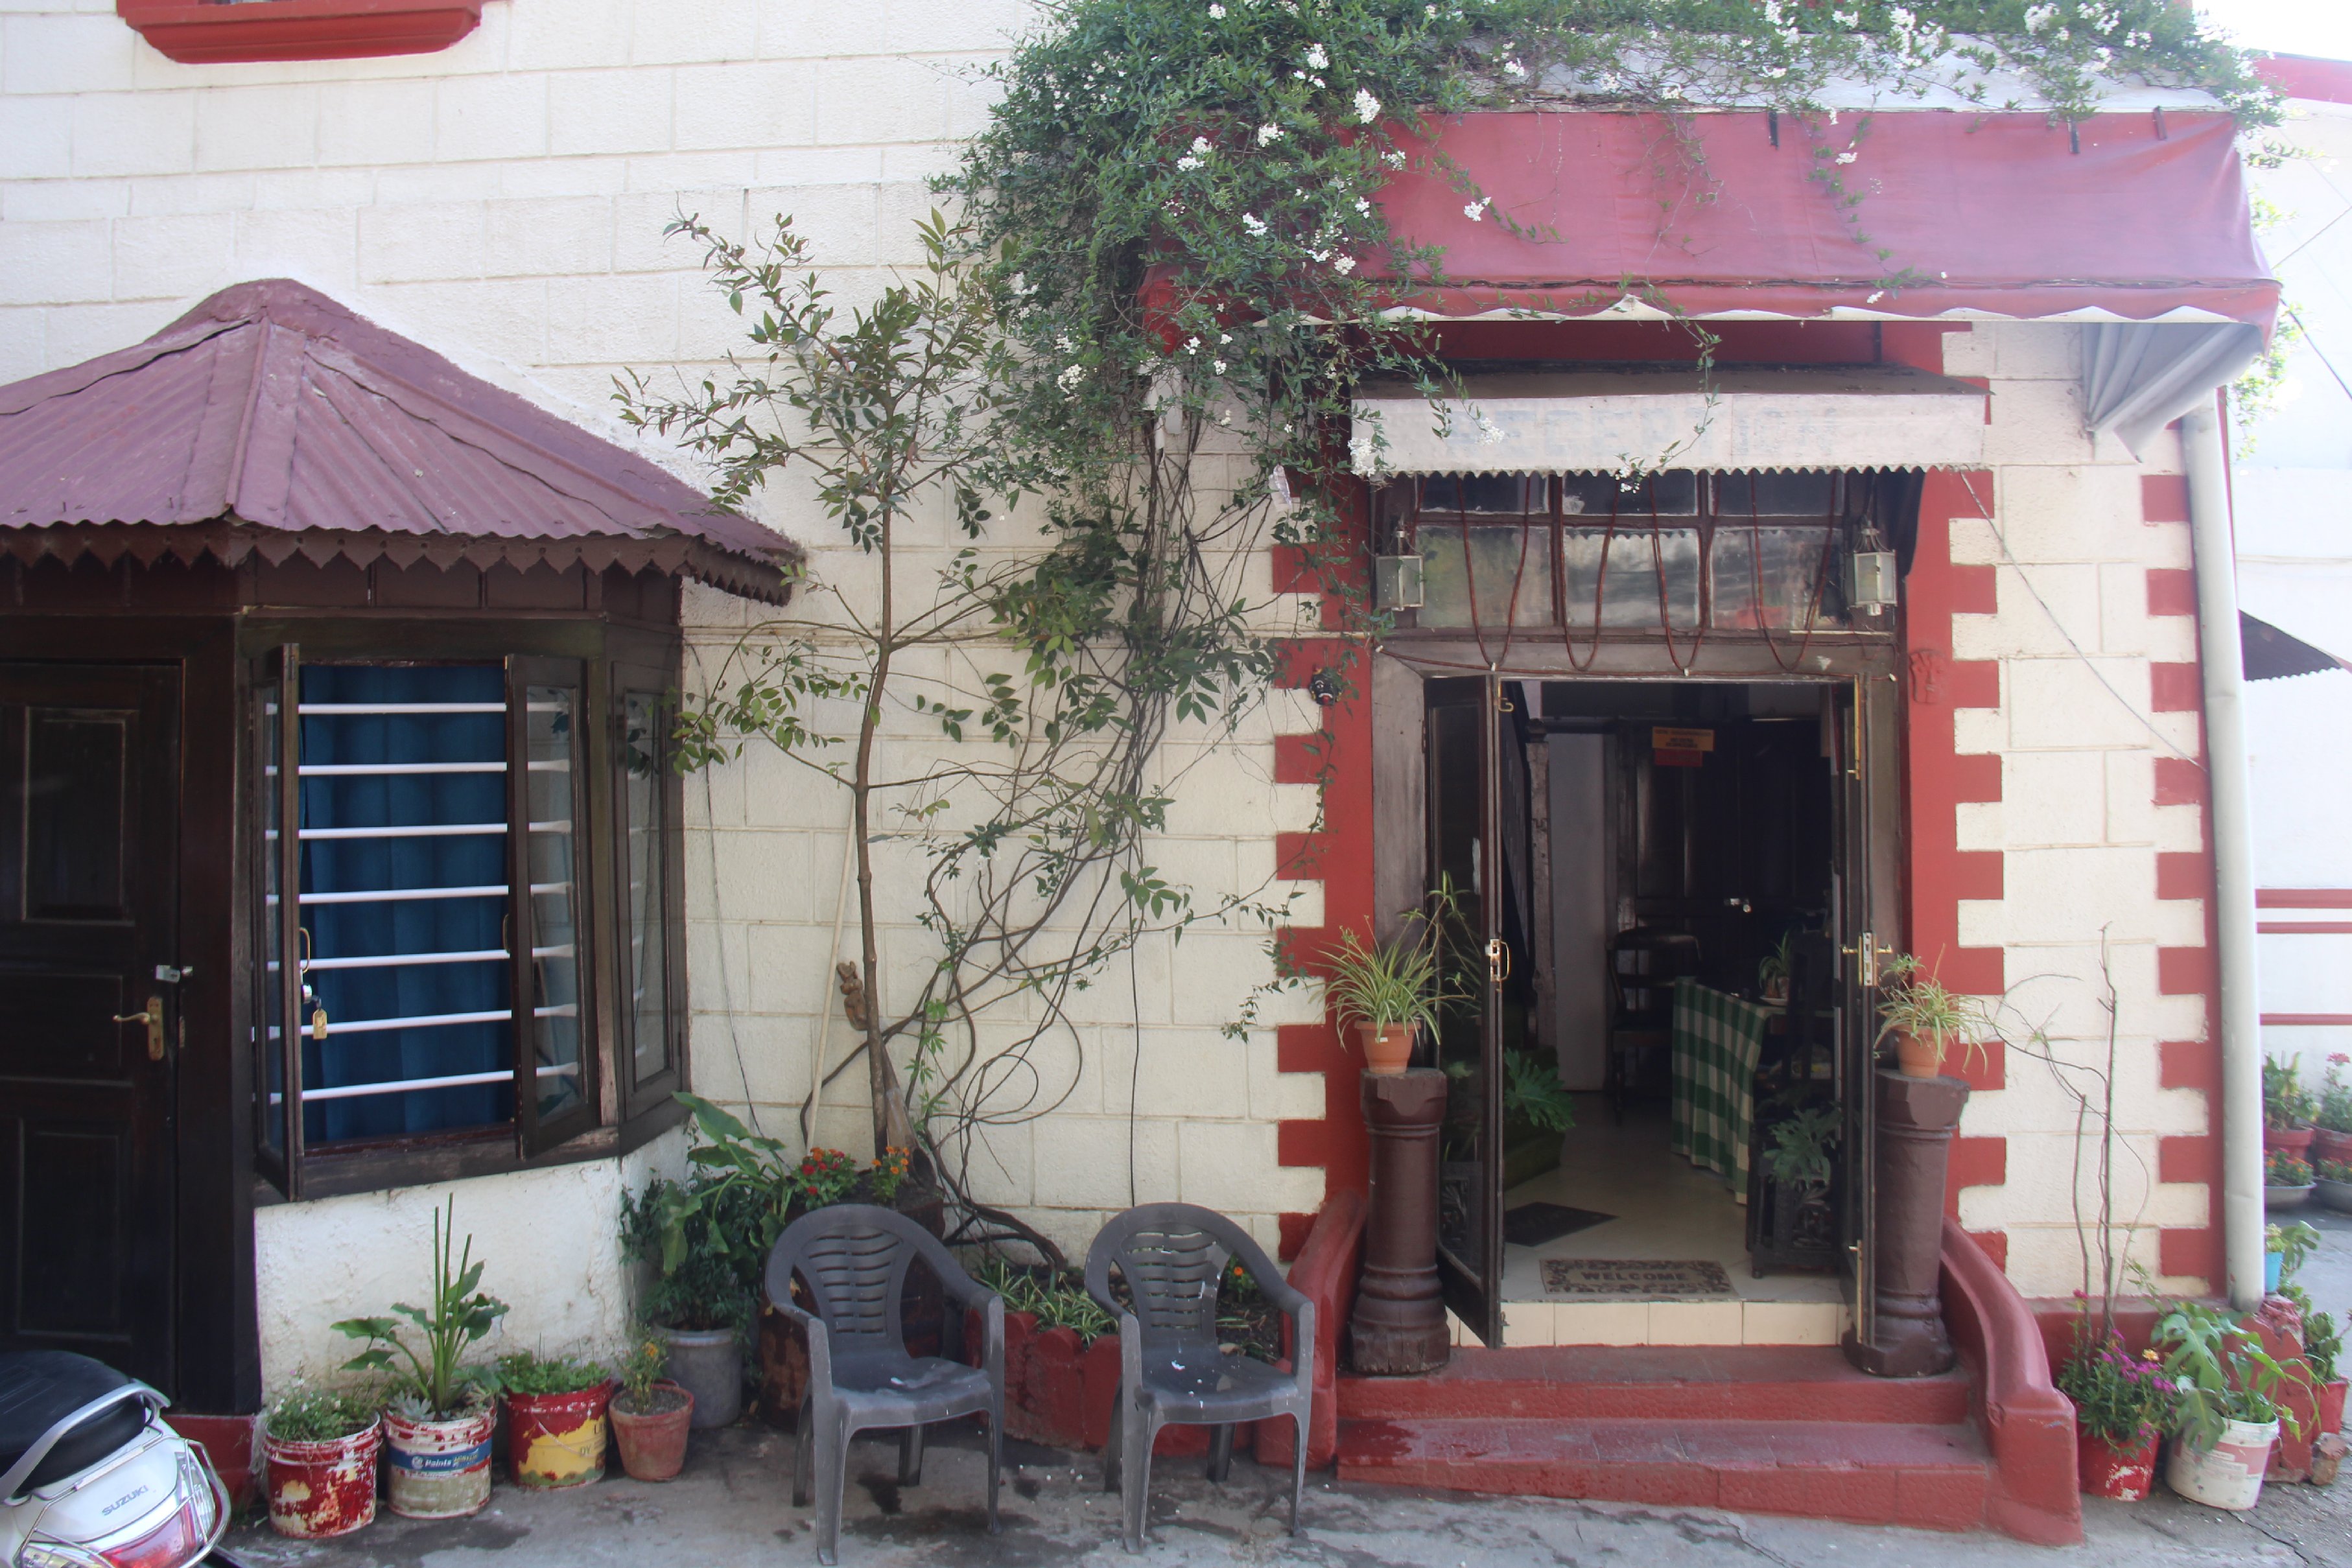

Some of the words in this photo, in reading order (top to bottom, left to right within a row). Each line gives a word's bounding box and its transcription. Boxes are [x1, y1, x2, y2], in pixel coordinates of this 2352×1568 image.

[1581, 1271, 1689, 1281] WELCOME
[425, 1458, 453, 1468] Paints
[101, 1484, 149, 1516] SUZUKI
